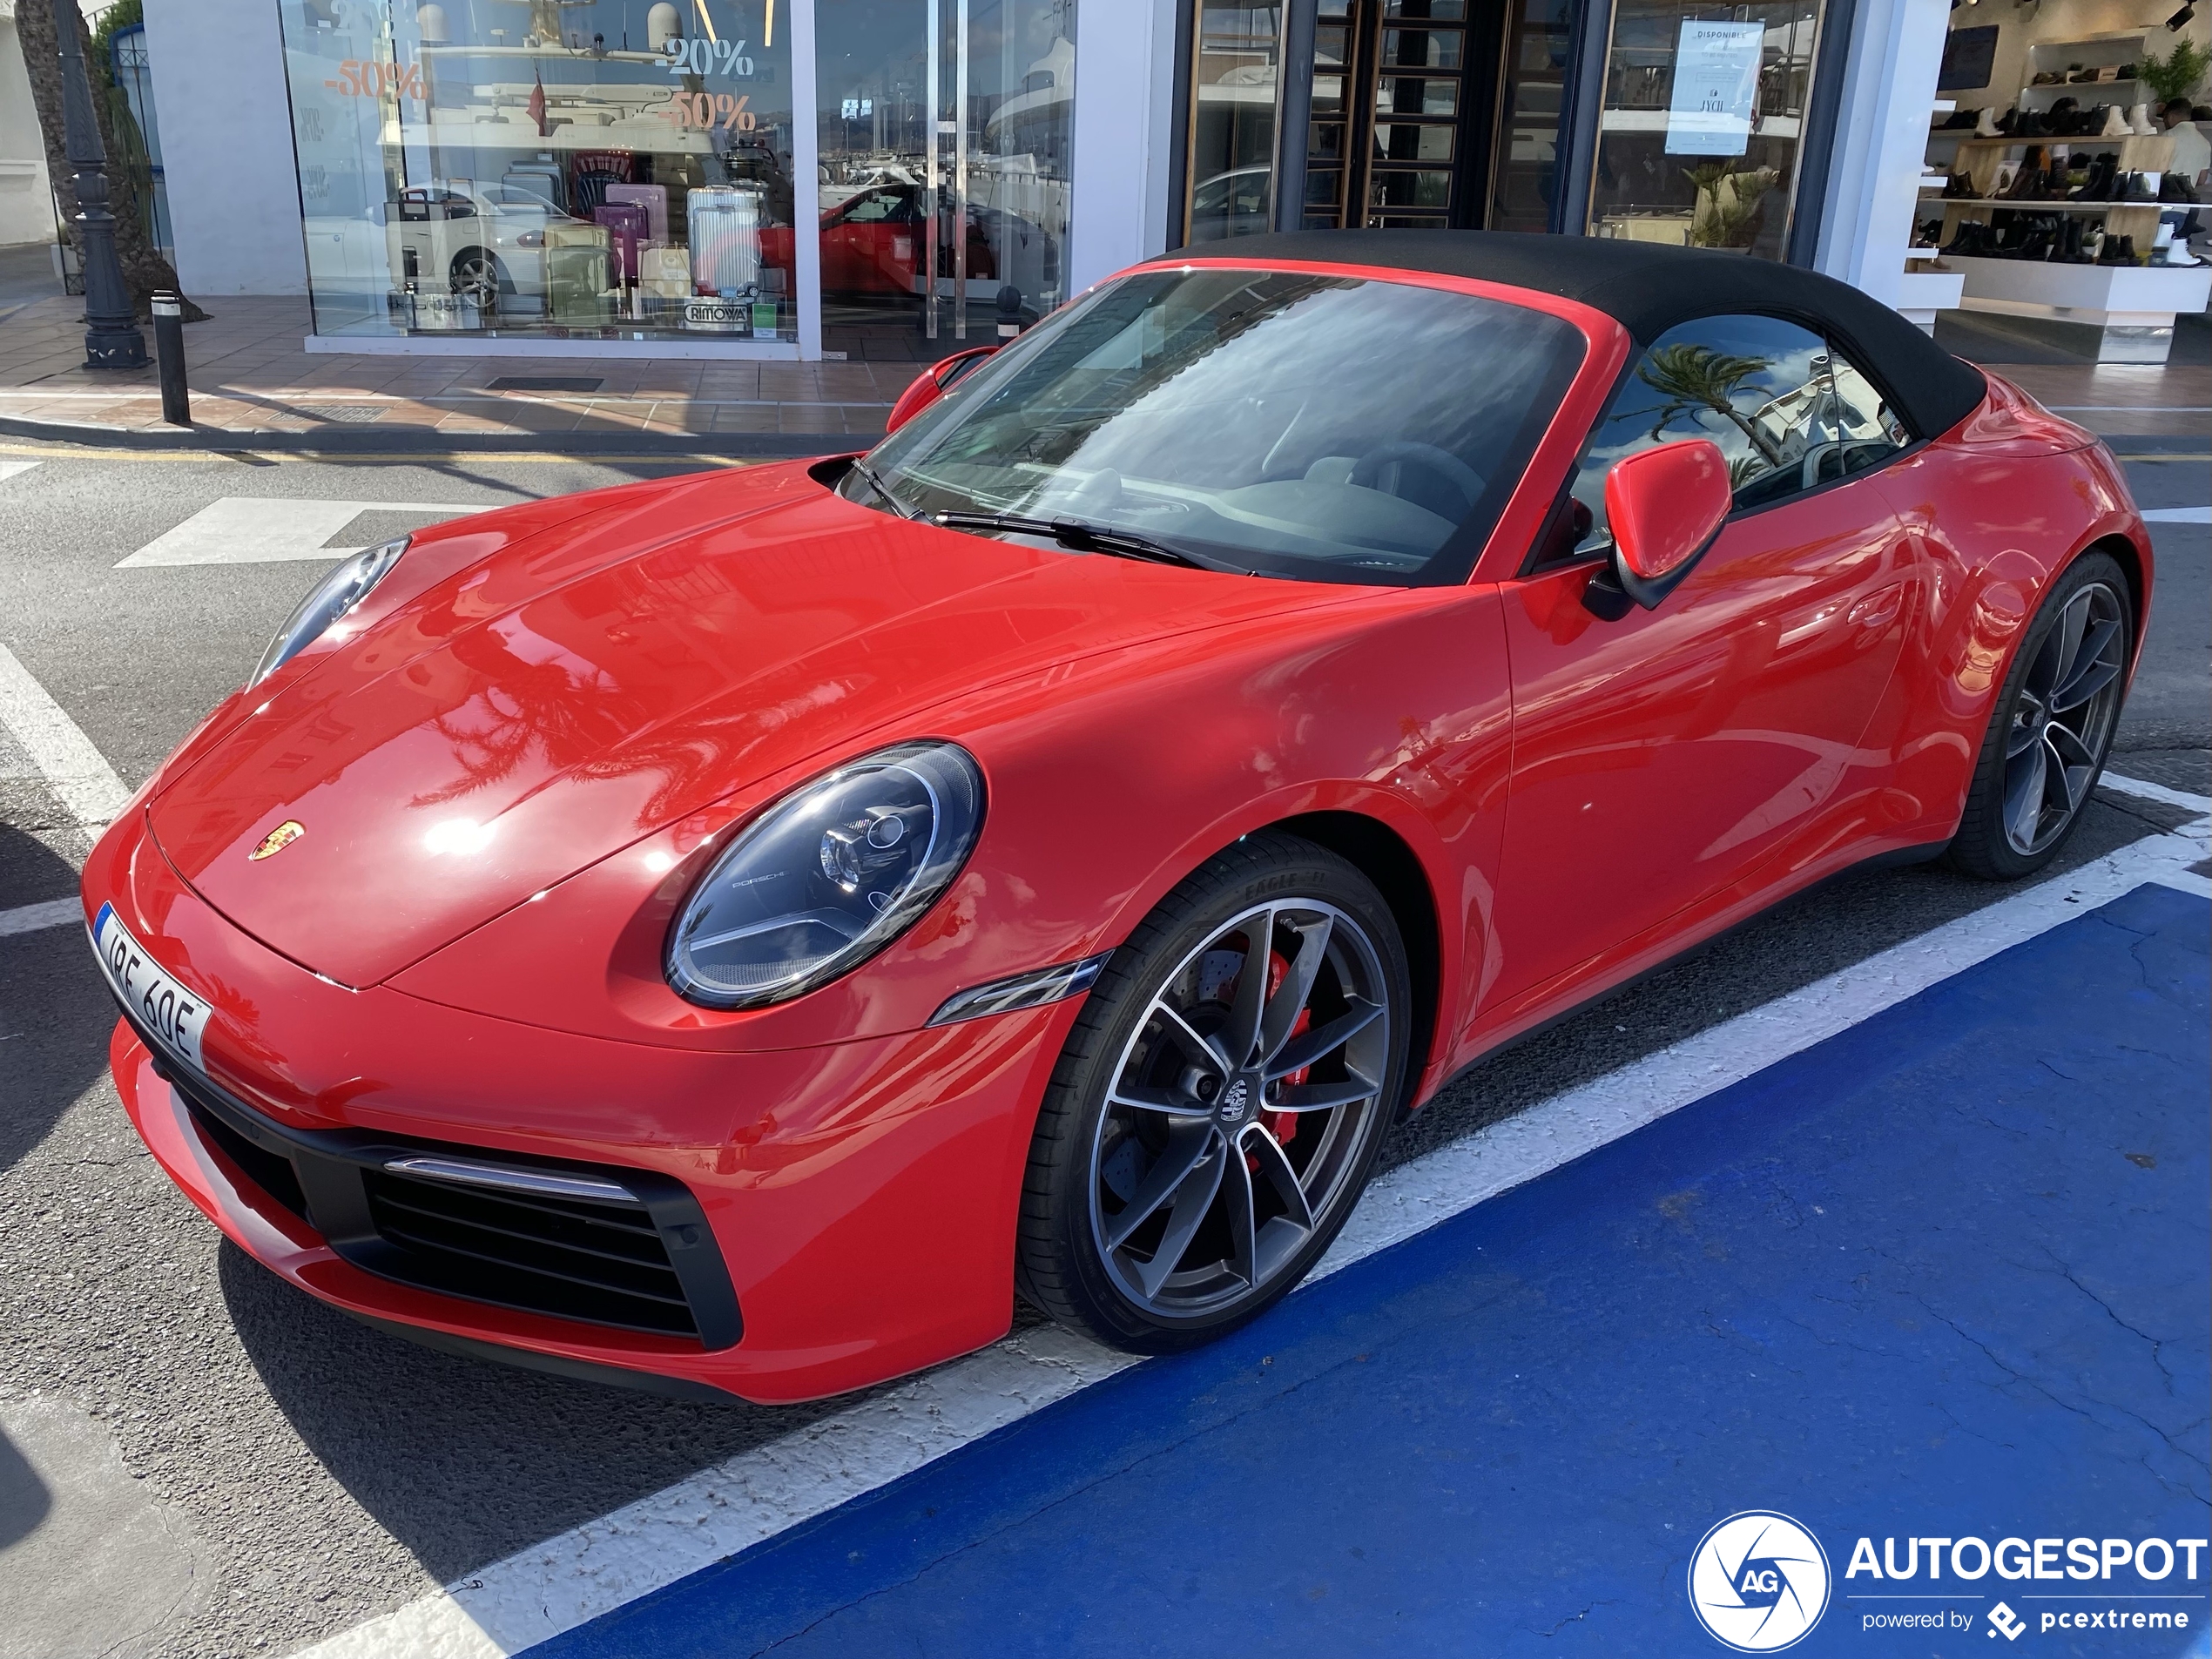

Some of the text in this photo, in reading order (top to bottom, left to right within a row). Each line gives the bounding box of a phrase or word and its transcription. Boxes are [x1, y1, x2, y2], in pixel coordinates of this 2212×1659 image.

[1697, 30, 1746, 39] DISPONIBLE
[655, 38, 754, 76] -20%
[324, 59, 428, 100] -50%
[658, 91, 757, 131] -50%
[691, 307, 745, 320] RIMOWA
[1245, 873, 1298, 901] EAGLE
[144, 979, 195, 1058] 60E
